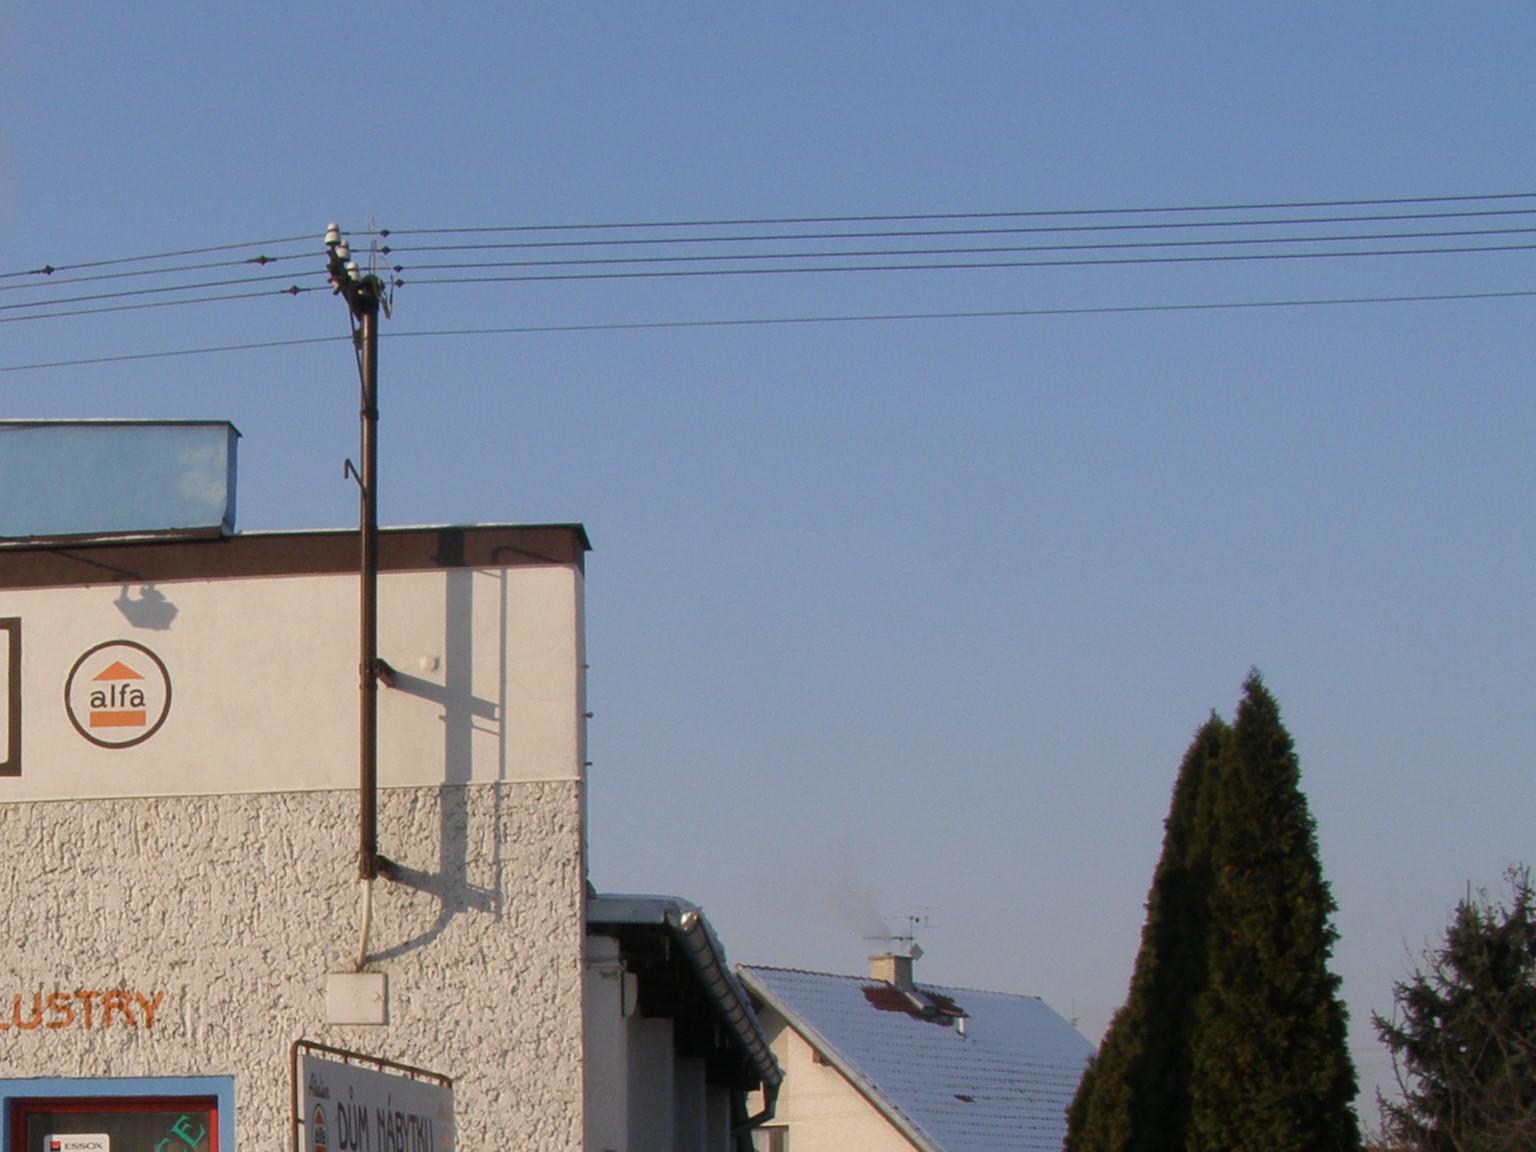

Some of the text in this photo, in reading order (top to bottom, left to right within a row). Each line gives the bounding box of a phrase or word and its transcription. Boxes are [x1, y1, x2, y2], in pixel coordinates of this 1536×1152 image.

[89, 681, 148, 711] alfa
[337, 1085, 370, 1152] DŮM
[64, 1142, 104, 1151] ESSOX
